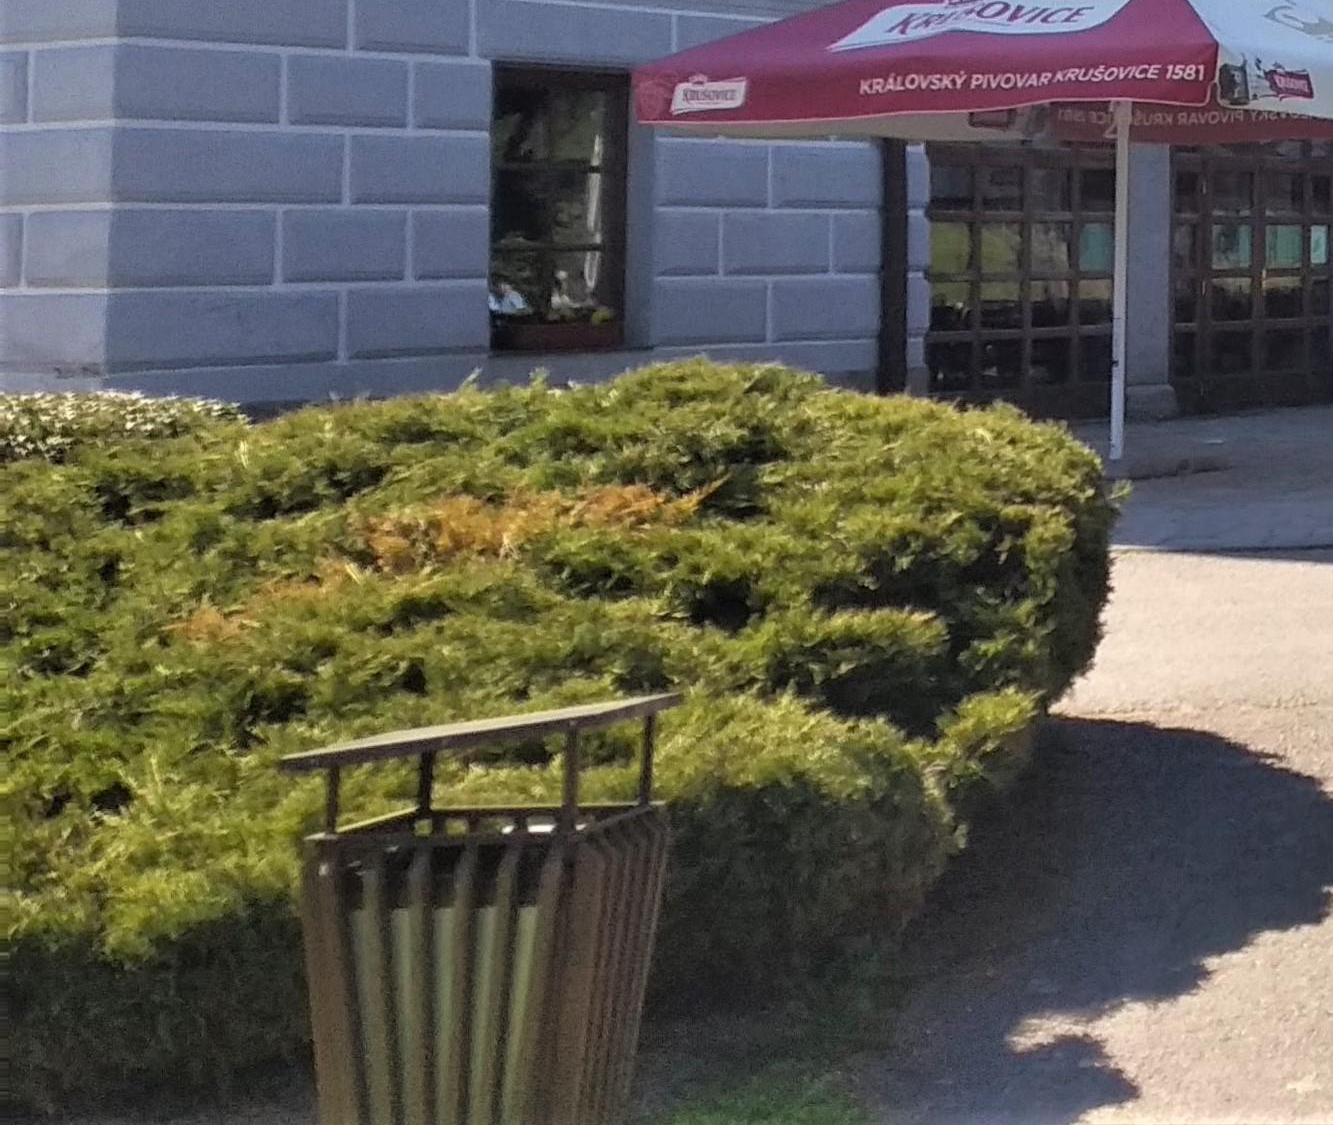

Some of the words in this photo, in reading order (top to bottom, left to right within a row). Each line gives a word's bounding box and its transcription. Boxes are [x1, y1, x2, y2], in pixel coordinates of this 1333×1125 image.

[859, 70, 965, 95] KRÁLOVSKÝ
[970, 72, 1052, 90] PIVOVAR
[1052, 64, 1161, 83] KRUŠOVICE
[1165, 63, 1205, 82] 1581
